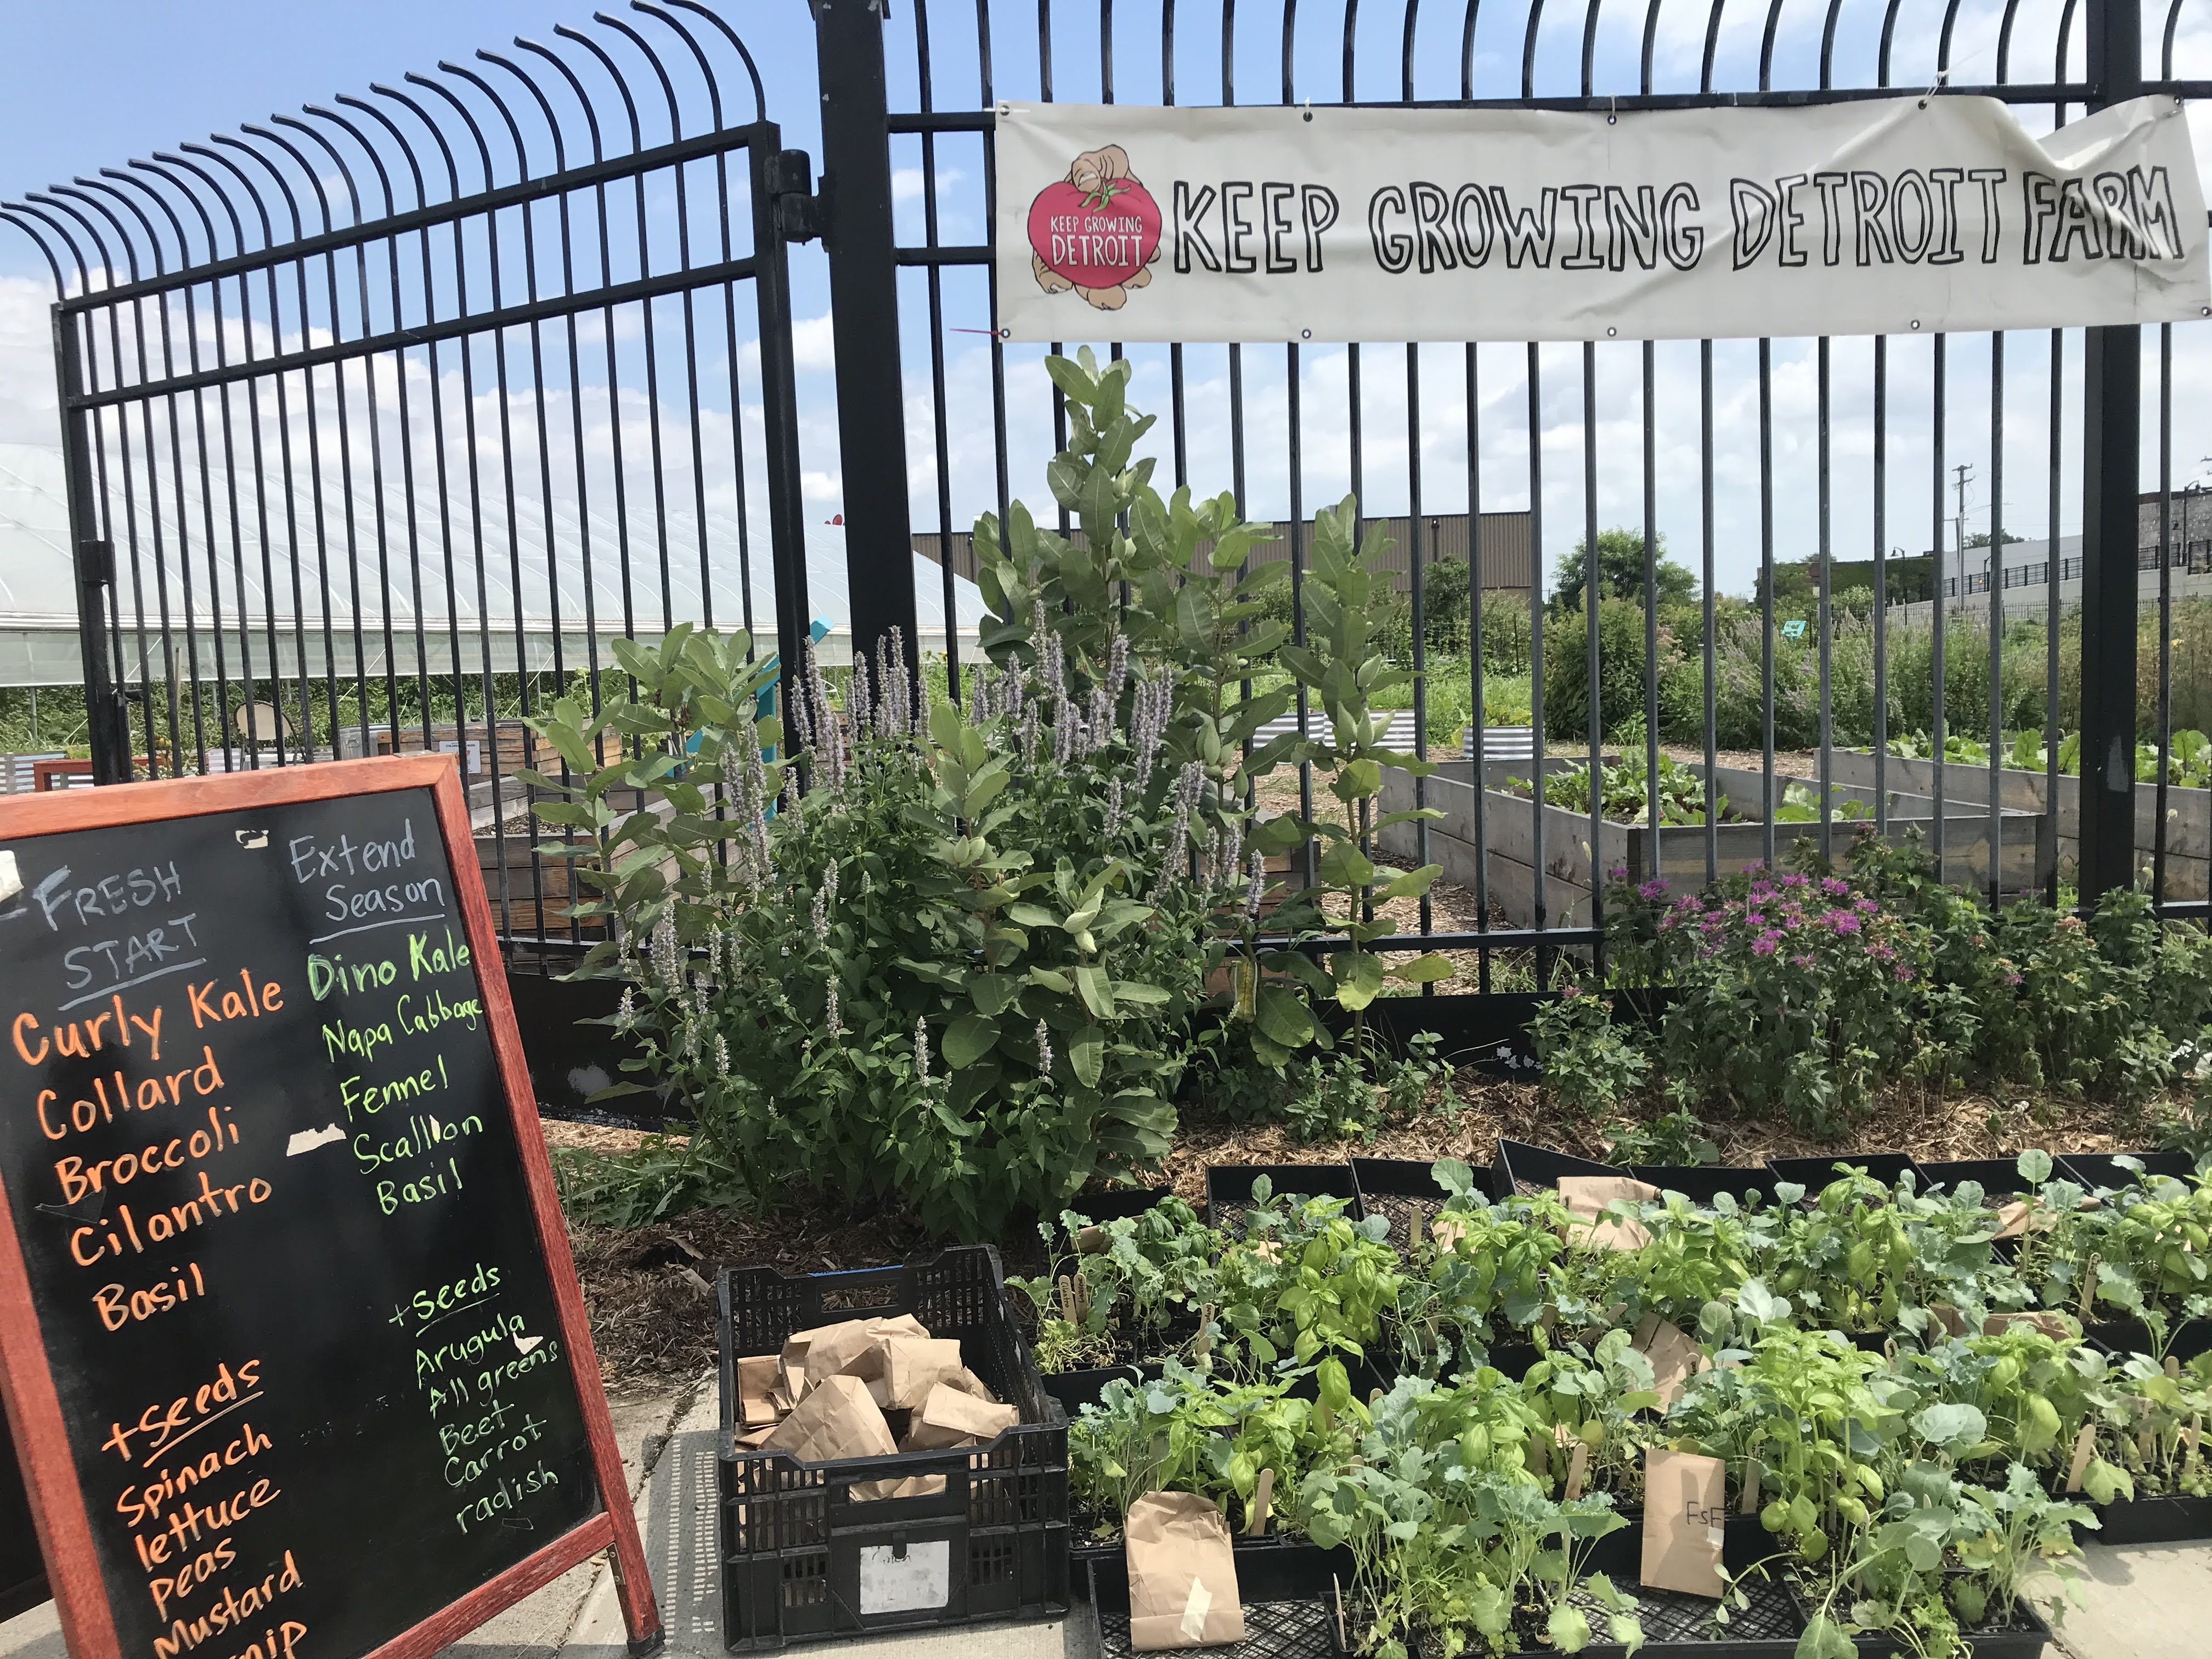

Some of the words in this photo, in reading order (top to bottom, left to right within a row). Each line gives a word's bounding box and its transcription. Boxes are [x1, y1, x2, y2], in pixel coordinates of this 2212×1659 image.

[1050, 216, 1079, 233] KEEP
[1084, 216, 1142, 233] GROWING
[1051, 234, 1143, 267] DETROIT
[1173, 181, 1339, 274] KEEP
[1369, 182, 1703, 274] GROWING
[1730, 168, 2007, 271] DETROIT
[2023, 165, 2184, 265] FARM
[289, 818, 415, 882] Extend
[33, 861, 181, 931] FRESH
[326, 878, 445, 921] Season
[64, 913, 198, 989] START
[308, 955, 397, 1001] Dino
[409, 930, 470, 980] Kale
[13, 995, 161, 1065] Curly
[188, 968, 283, 1029] Kale
[323, 1020, 393, 1062] Napa
[397, 990, 483, 1034] Cabbage
[37, 1046, 223, 1140] Collard
[340, 1054, 448, 1121] Fennel
[55, 1106, 239, 1205] Broccoli
[376, 1158, 463, 1215] Basil
[71, 1172, 271, 1266] Cilantro
[92, 1262, 205, 1331] Basil
[415, 1314, 525, 1390] Arugula
[429, 1377, 470, 1419] All
[477, 1340, 558, 1406] greens
[439, 1399, 515, 1457] Beet
[443, 1413, 547, 1488] Carrot
[117, 1423, 273, 1527] Spinach
[455, 1459, 559, 1534] radish
[153, 1549, 303, 1659] Mustard
